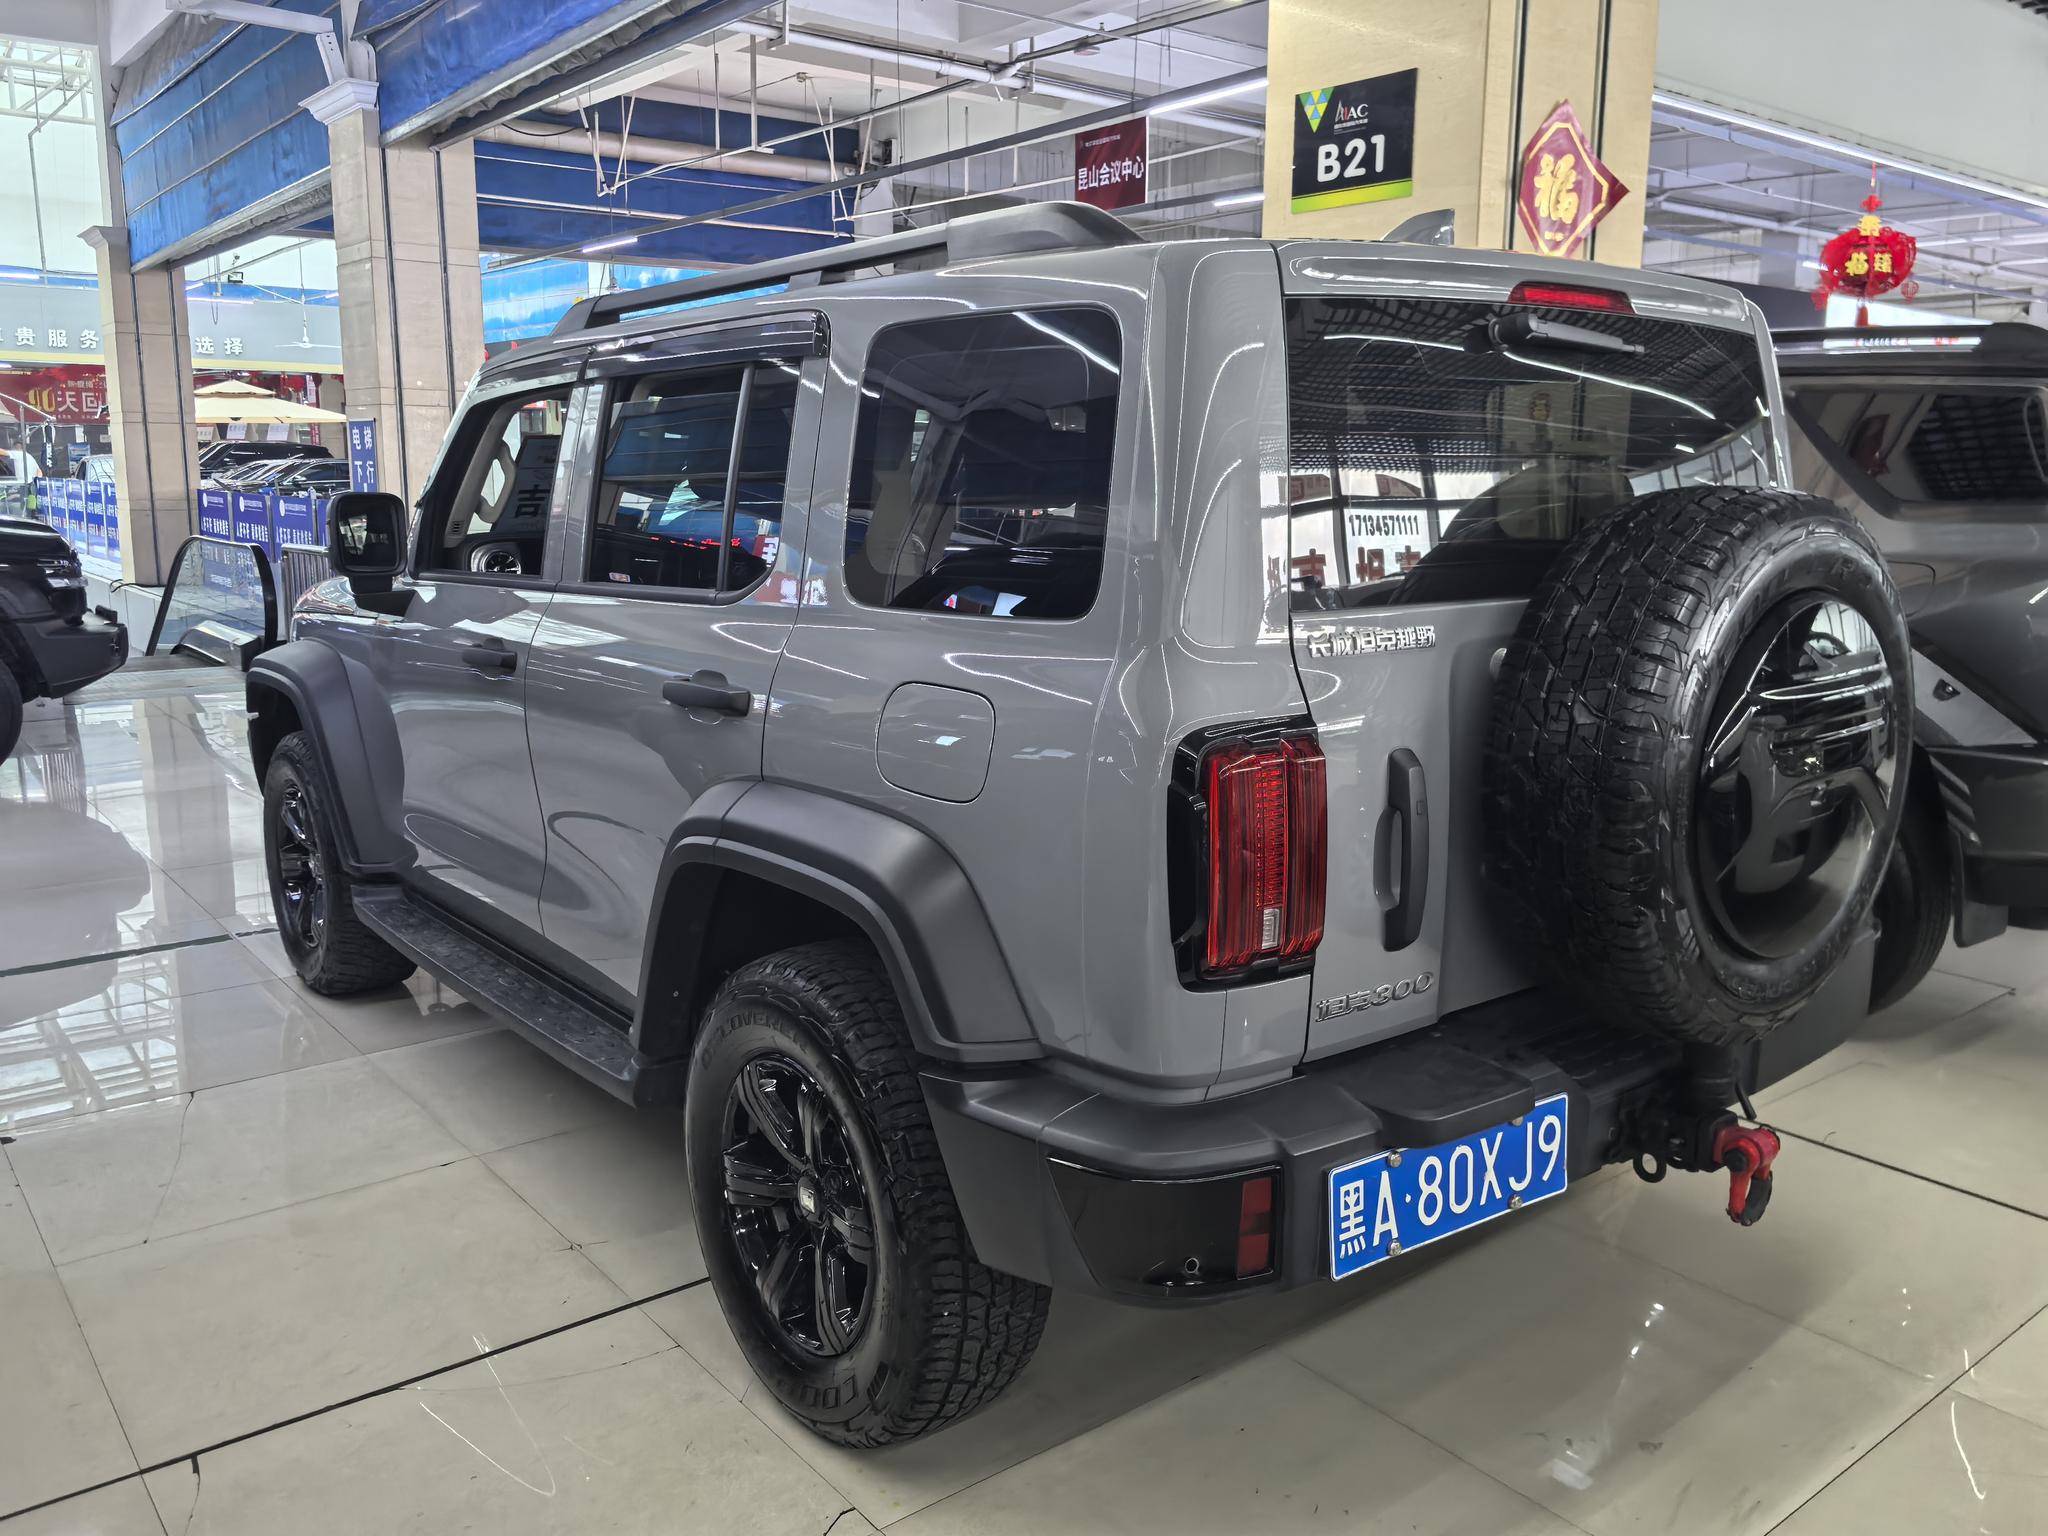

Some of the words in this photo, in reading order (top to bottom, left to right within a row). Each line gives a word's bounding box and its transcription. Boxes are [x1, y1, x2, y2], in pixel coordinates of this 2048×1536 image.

[1078, 156, 1144, 190] 昆山会议中心
[1317, 134, 1386, 183] B21
[1533, 153, 1579, 224] 福
[0, 326, 100, 349] 贵服务
[194, 336, 244, 356] 选择
[352, 426, 373, 450] 电梯
[353, 460, 375, 485] 下行
[1306, 624, 1437, 659] 长城坦克越野
[1315, 971, 1434, 1023] 坦克300
[1339, 1114, 1562, 1260] 黑A·80XJ9
